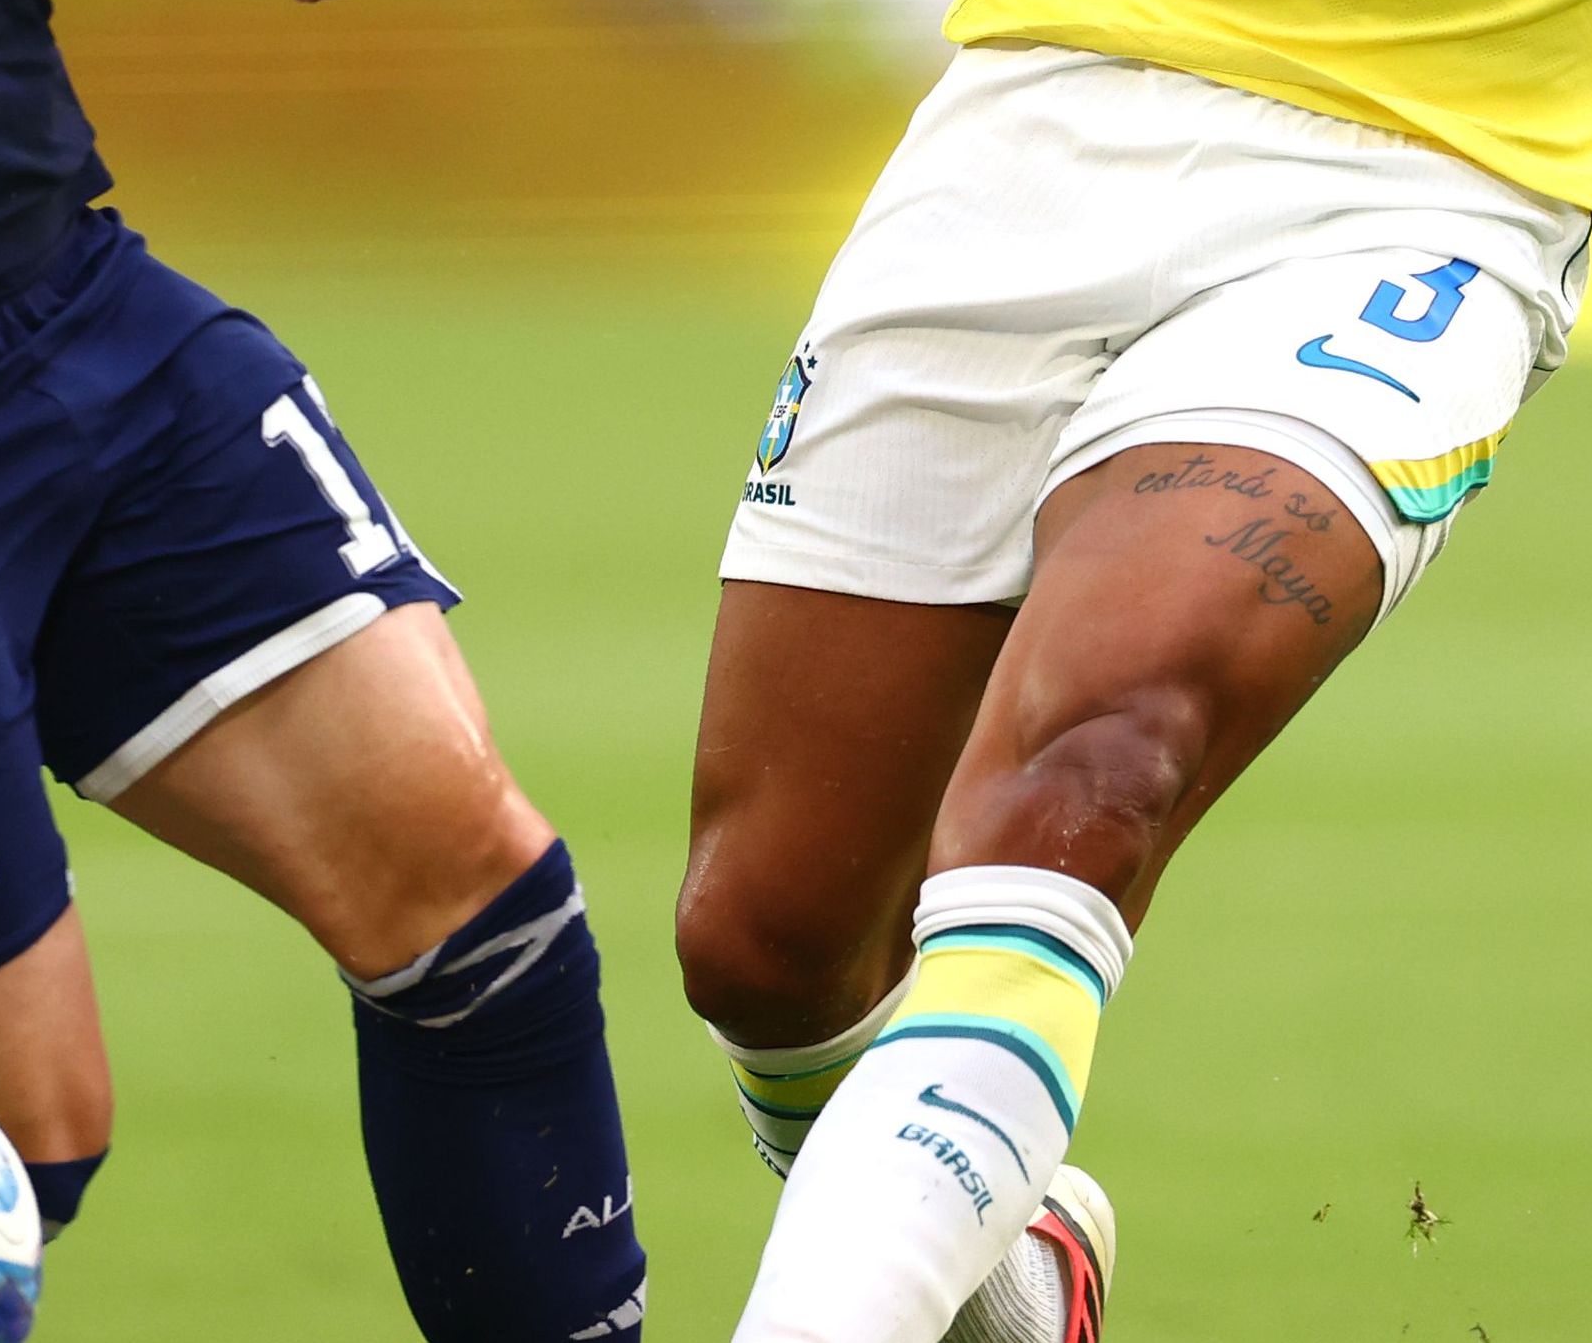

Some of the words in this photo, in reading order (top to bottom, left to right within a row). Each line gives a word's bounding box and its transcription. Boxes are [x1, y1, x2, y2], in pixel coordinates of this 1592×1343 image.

[1359, 258, 1481, 342] 3
[1205, 518, 1332, 626] Maya
[896, 1123, 995, 1226] BRASIL
